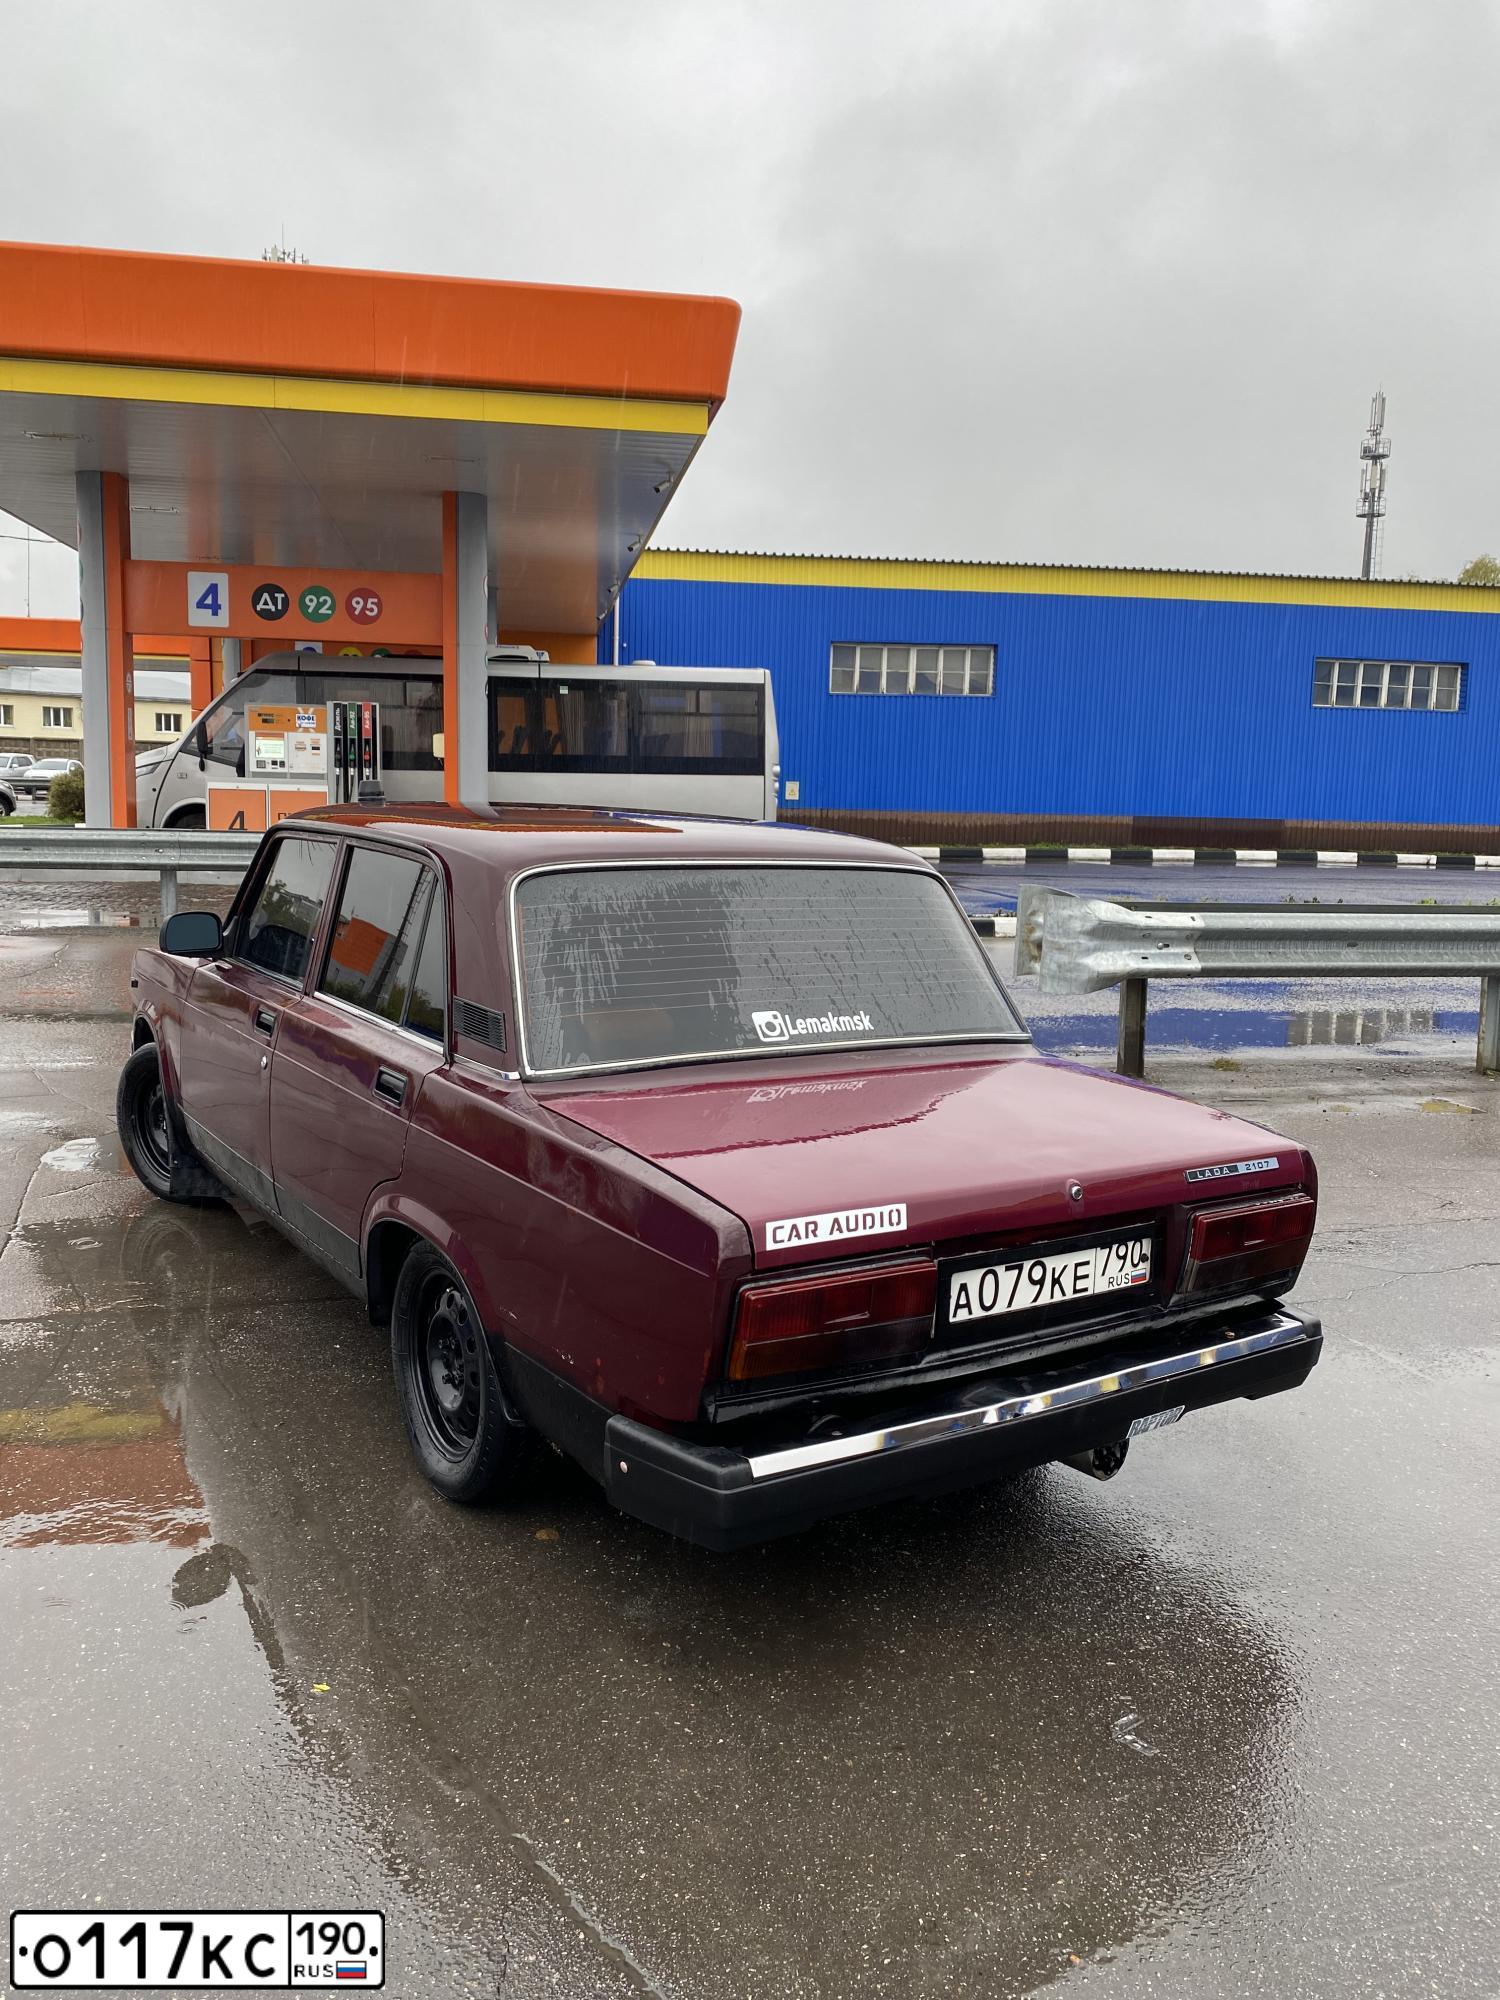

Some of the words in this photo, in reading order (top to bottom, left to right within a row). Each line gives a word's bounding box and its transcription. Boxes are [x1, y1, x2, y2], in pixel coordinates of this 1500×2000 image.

[195, 583, 222, 617] 4
[256, 592, 285, 612] ДТ
[304, 595, 332, 614] 92
[351, 597, 378, 616] 95
[784, 1010, 875, 1035] Lemakmsk
[1196, 1167, 1230, 1179] LADA
[1245, 1160, 1270, 1171] 2107
[772, 1221, 819, 1244] CAR
[829, 1208, 902, 1236] AUDIO
[1101, 1240, 1144, 1277] 790
[1107, 1273, 1130, 1288] RUS
